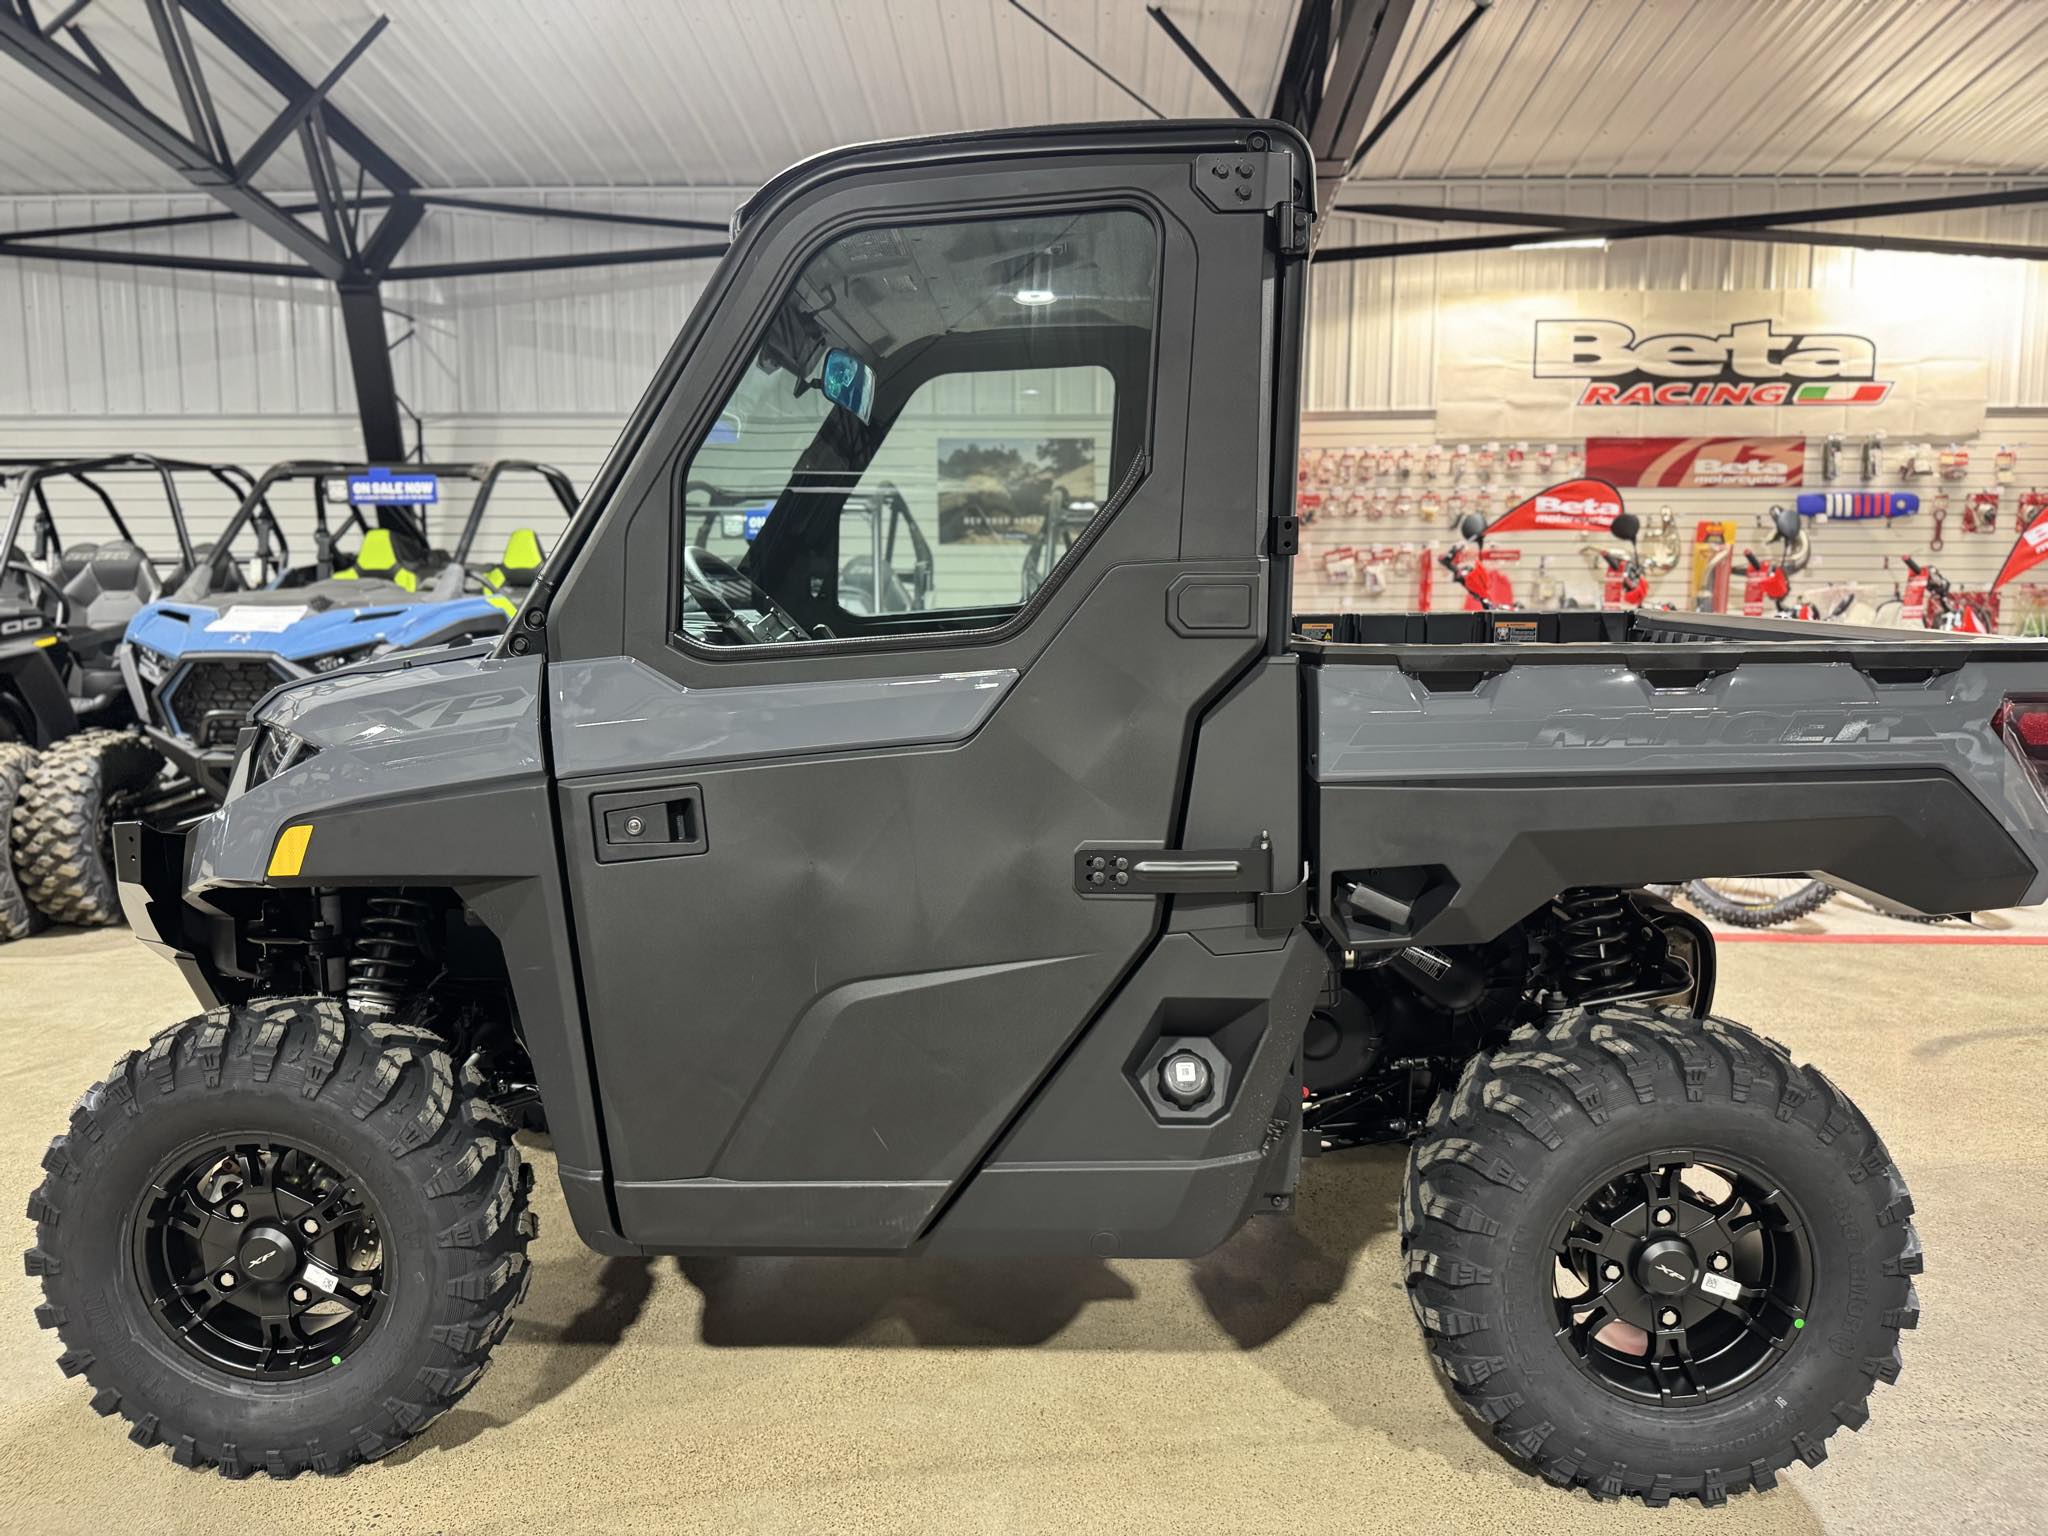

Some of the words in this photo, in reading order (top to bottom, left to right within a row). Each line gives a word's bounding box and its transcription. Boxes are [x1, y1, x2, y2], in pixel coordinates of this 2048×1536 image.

[1533, 318, 1876, 380] Beta
[1579, 382, 1793, 406] RACING
[1694, 459, 1788, 474] Beta
[352, 482, 370, 494] ON
[372, 482, 404, 494] SALE
[405, 482, 434, 494] NOW
[1535, 496, 1620, 515] Beta
[347, 686, 537, 742] XP
[1529, 710, 1903, 747] RANGER
[247, 1249, 277, 1270] XP
[1653, 1263, 1687, 1281] XP
